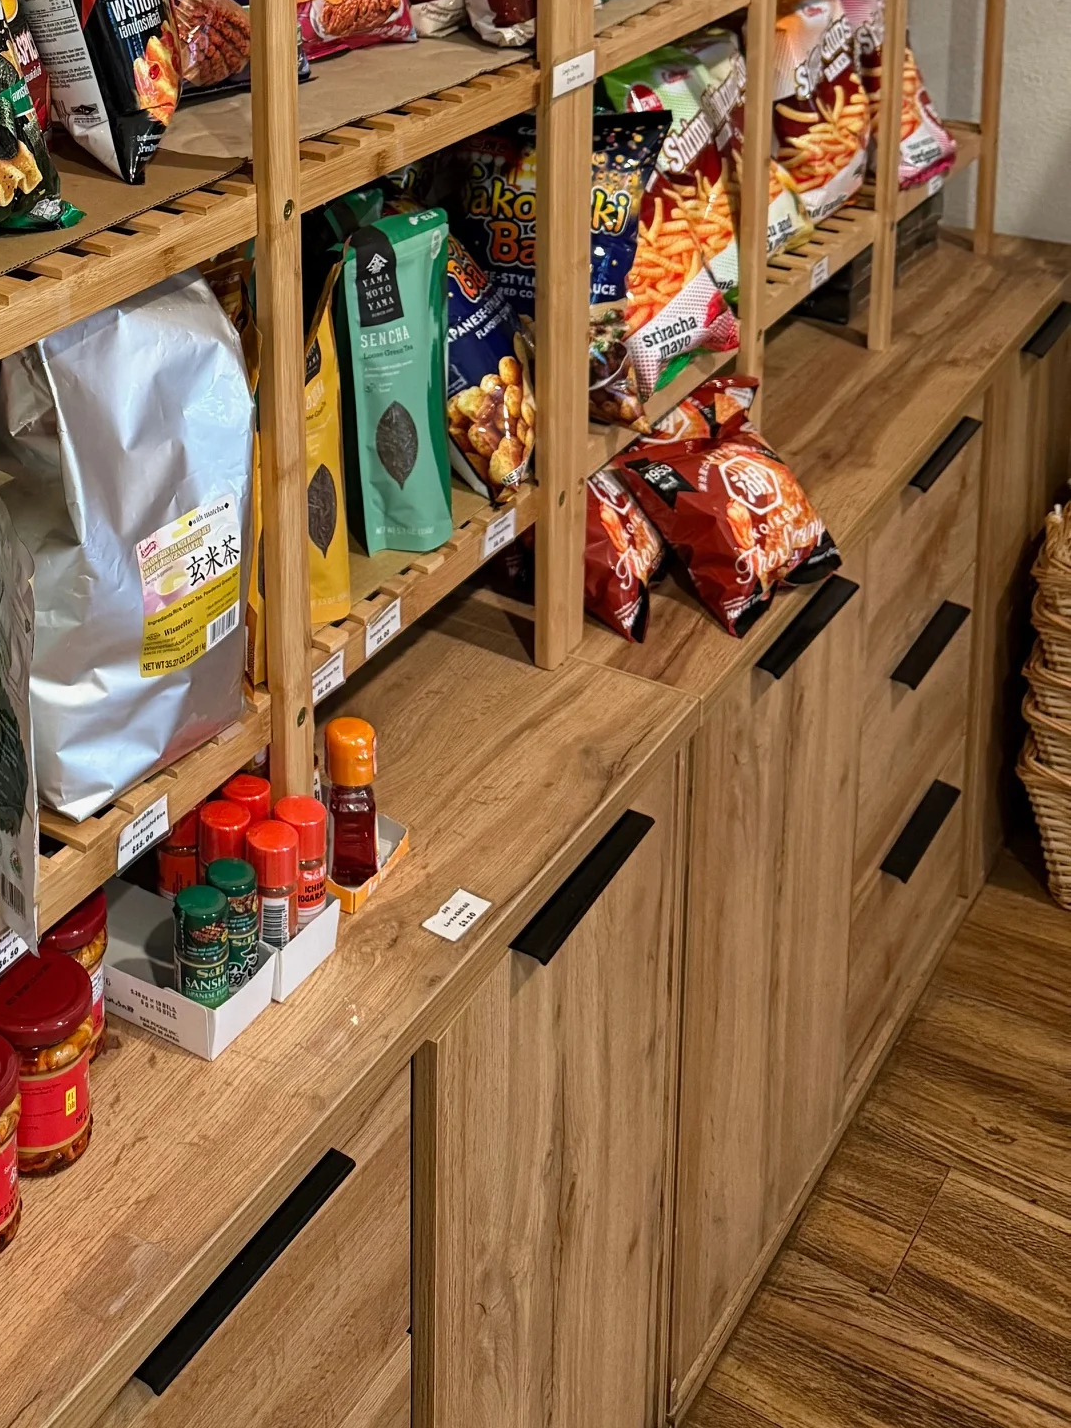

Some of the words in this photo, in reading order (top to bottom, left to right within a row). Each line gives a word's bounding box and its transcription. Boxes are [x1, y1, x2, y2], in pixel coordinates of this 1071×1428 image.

[362, 273, 391, 288] YAMA
[365, 285, 392, 300] MOTO
[367, 296, 395, 311] YAMA
[360, 325, 410, 349] SENCHA
[642, 314, 699, 348] sriracha
[363, 351, 383, 360] Loose
[384, 347, 404, 357] Green
[659, 333, 691, 360] mayo
[644, 464, 673, 485] 1953
[204, 505, 224, 519] matcha
[186, 534, 240, 587] 玄米茶
[143, 662, 154, 671] NET
[131, 832, 154, 854] $15.00
[196, 965, 225, 979] S&B
[185, 973, 229, 990] SANSHO
